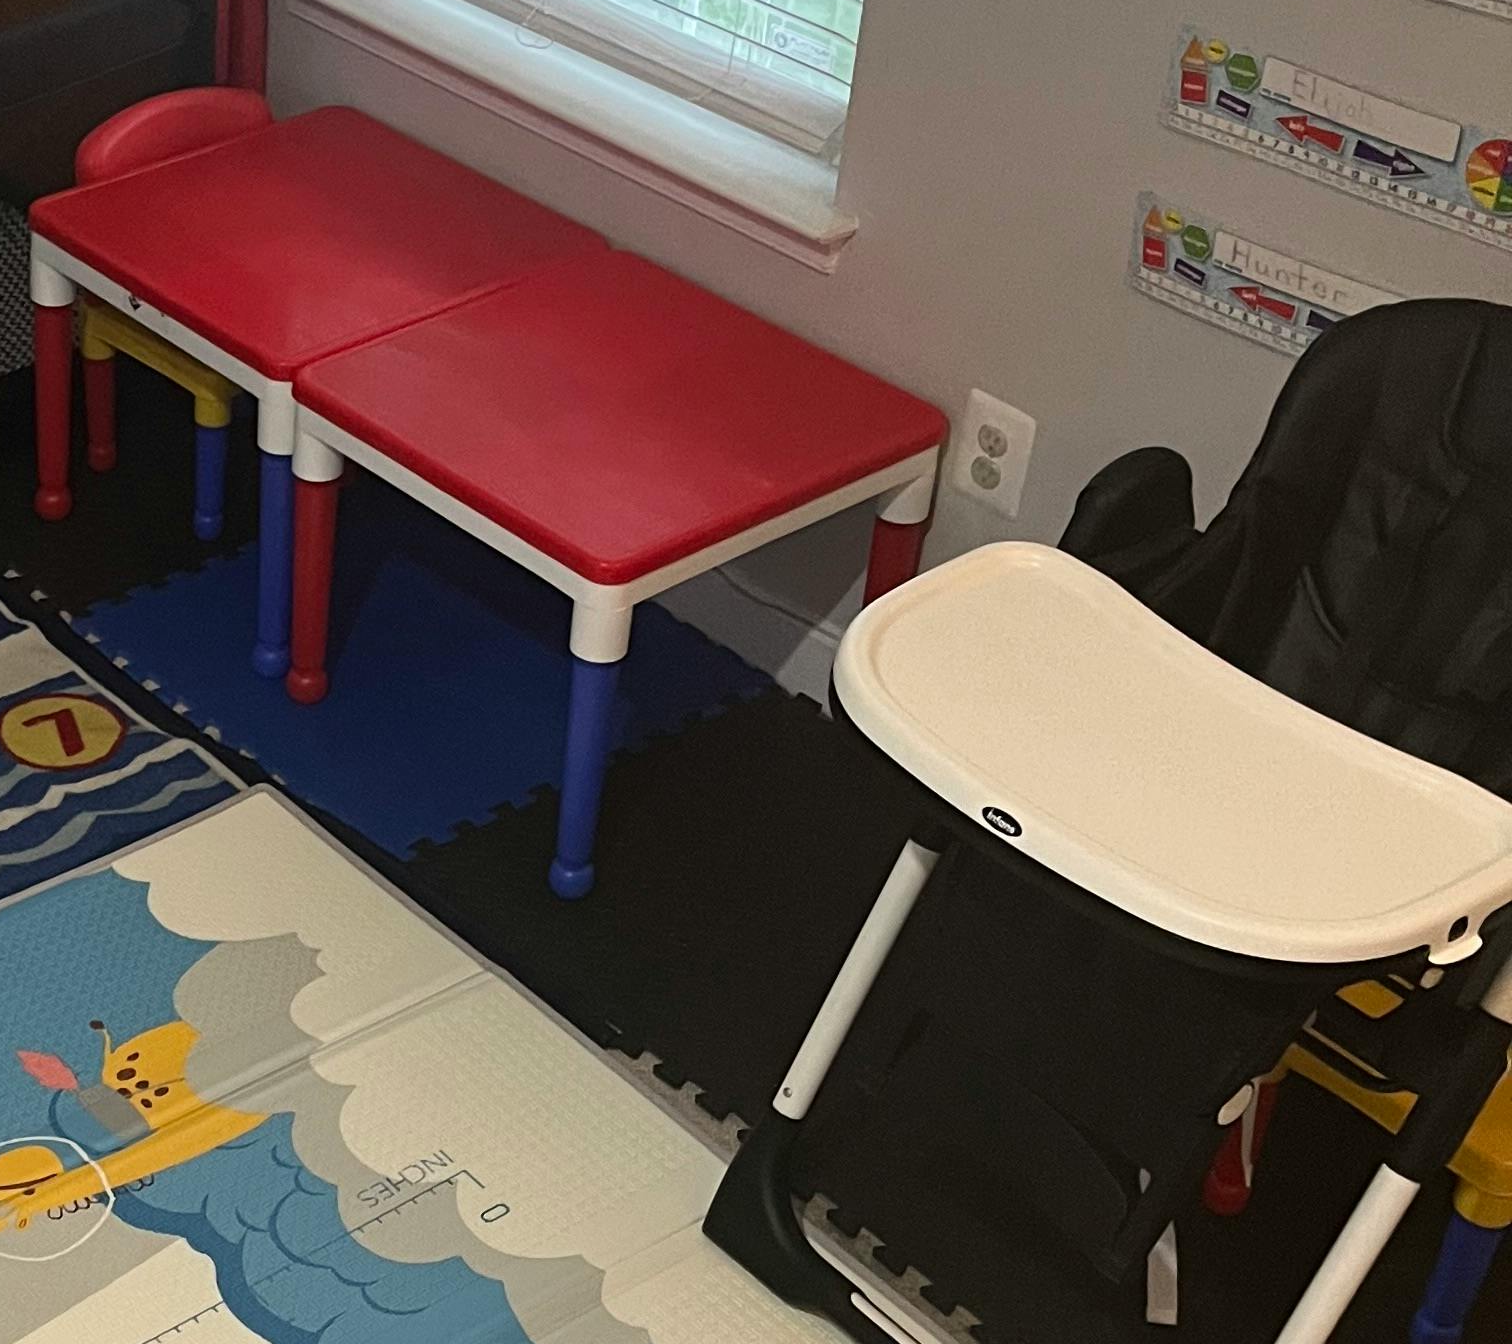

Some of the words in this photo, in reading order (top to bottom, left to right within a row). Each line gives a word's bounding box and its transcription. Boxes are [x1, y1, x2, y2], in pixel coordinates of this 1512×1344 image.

[1231, 239, 1349, 302] Hunter
[22, 707, 87, 757] 7
[356, 1149, 455, 1209] INCHES
[480, 1203, 510, 1223] 0
